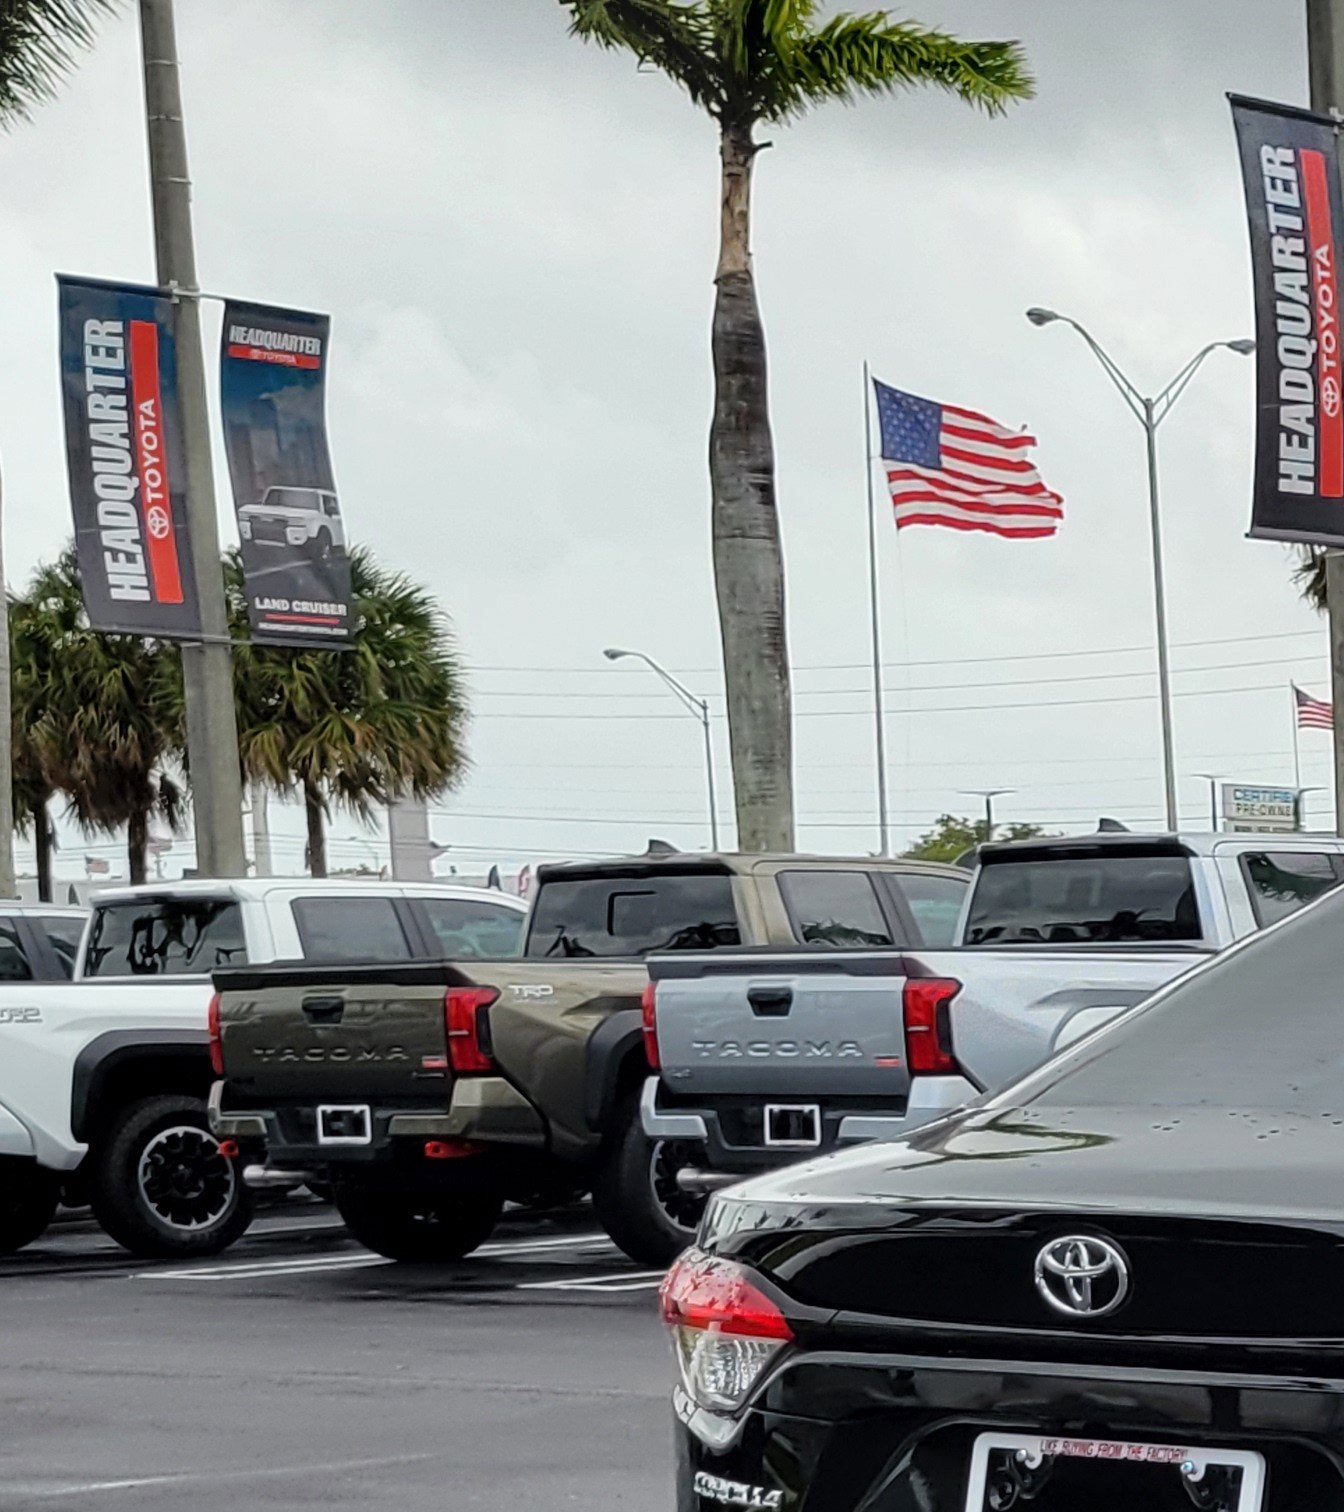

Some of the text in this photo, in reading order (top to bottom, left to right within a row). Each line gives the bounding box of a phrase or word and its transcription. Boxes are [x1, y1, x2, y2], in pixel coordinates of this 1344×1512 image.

[1315, 243, 1339, 372] TOYOTA
[1260, 145, 1317, 496] HEADQUARTER
[229, 325, 321, 355] HEADQUARTER
[84, 318, 151, 602] HEADQUARTER
[139, 398, 164, 503] TOYOTA
[254, 597, 347, 616] LAND CRUISER
[1233, 788, 1294, 803] CERTIFIE
[1234, 802, 1293, 817] PRE-OWNE
[253, 1046, 409, 1063] TACOMA
[692, 1040, 864, 1058] TACOMA
